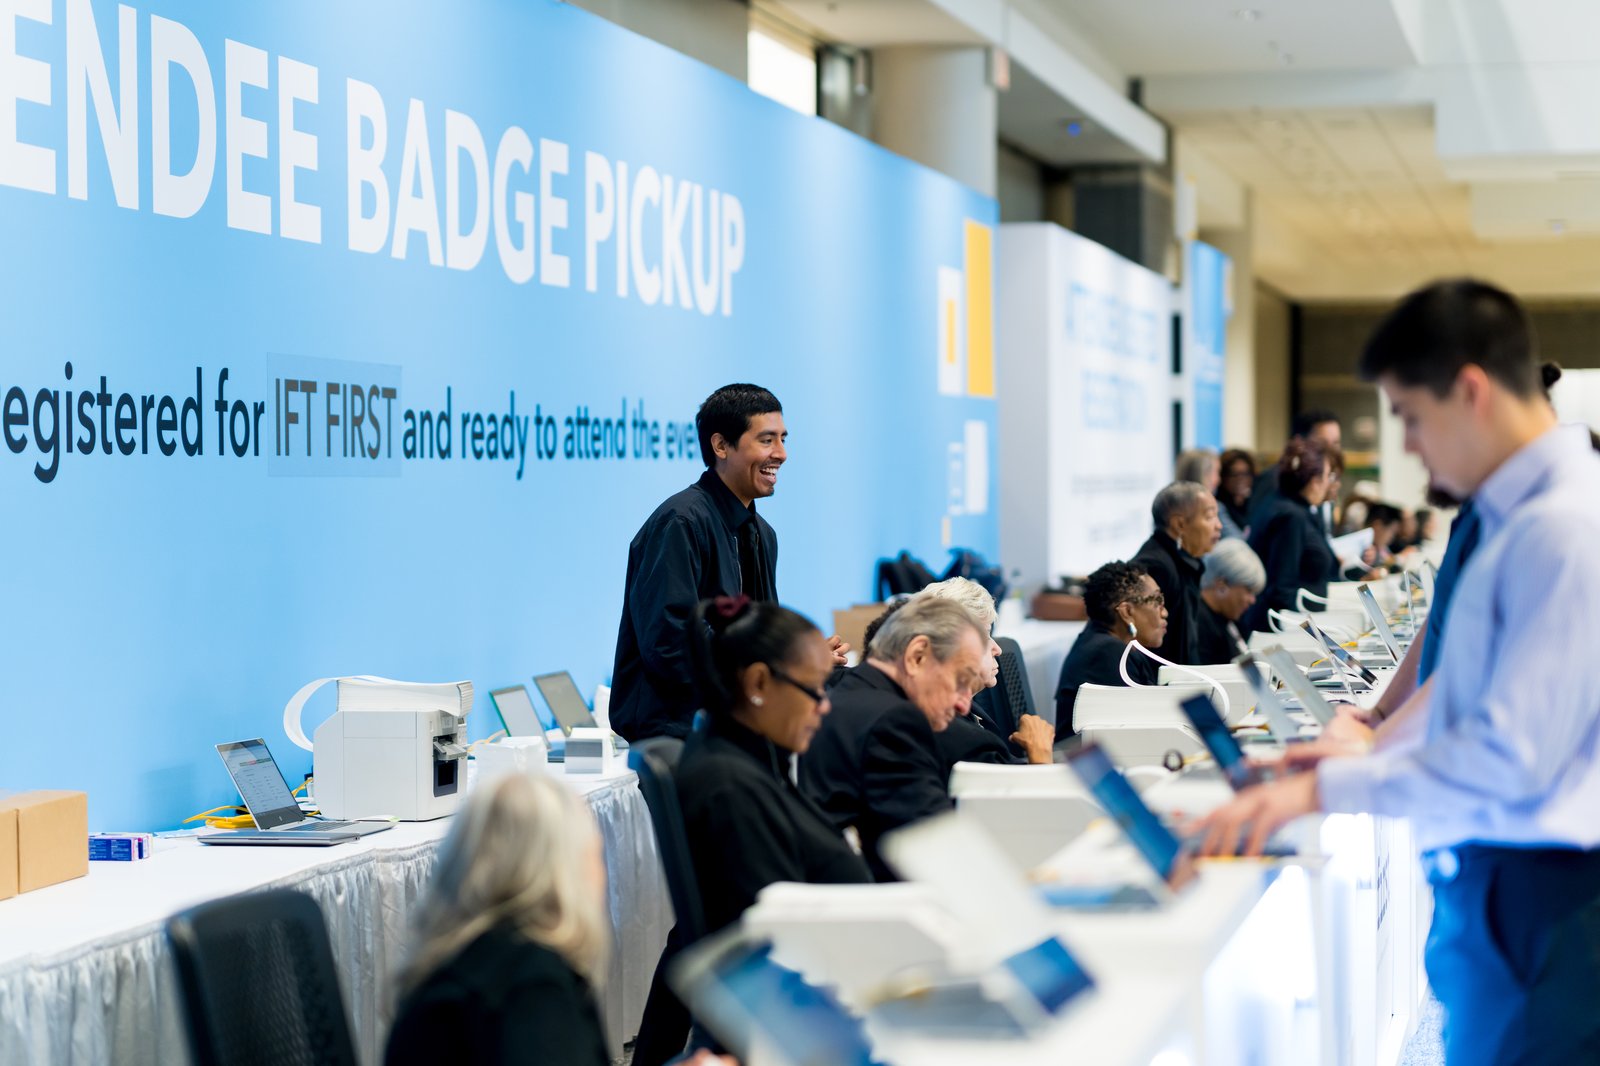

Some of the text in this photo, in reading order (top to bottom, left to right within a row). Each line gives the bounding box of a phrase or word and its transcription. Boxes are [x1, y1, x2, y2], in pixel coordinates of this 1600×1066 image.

[0, 0, 746, 318] ENDEE BADGE PICKUP
[0, 361, 700, 483] egistered for IFT FIRST and ready to attend the eve
